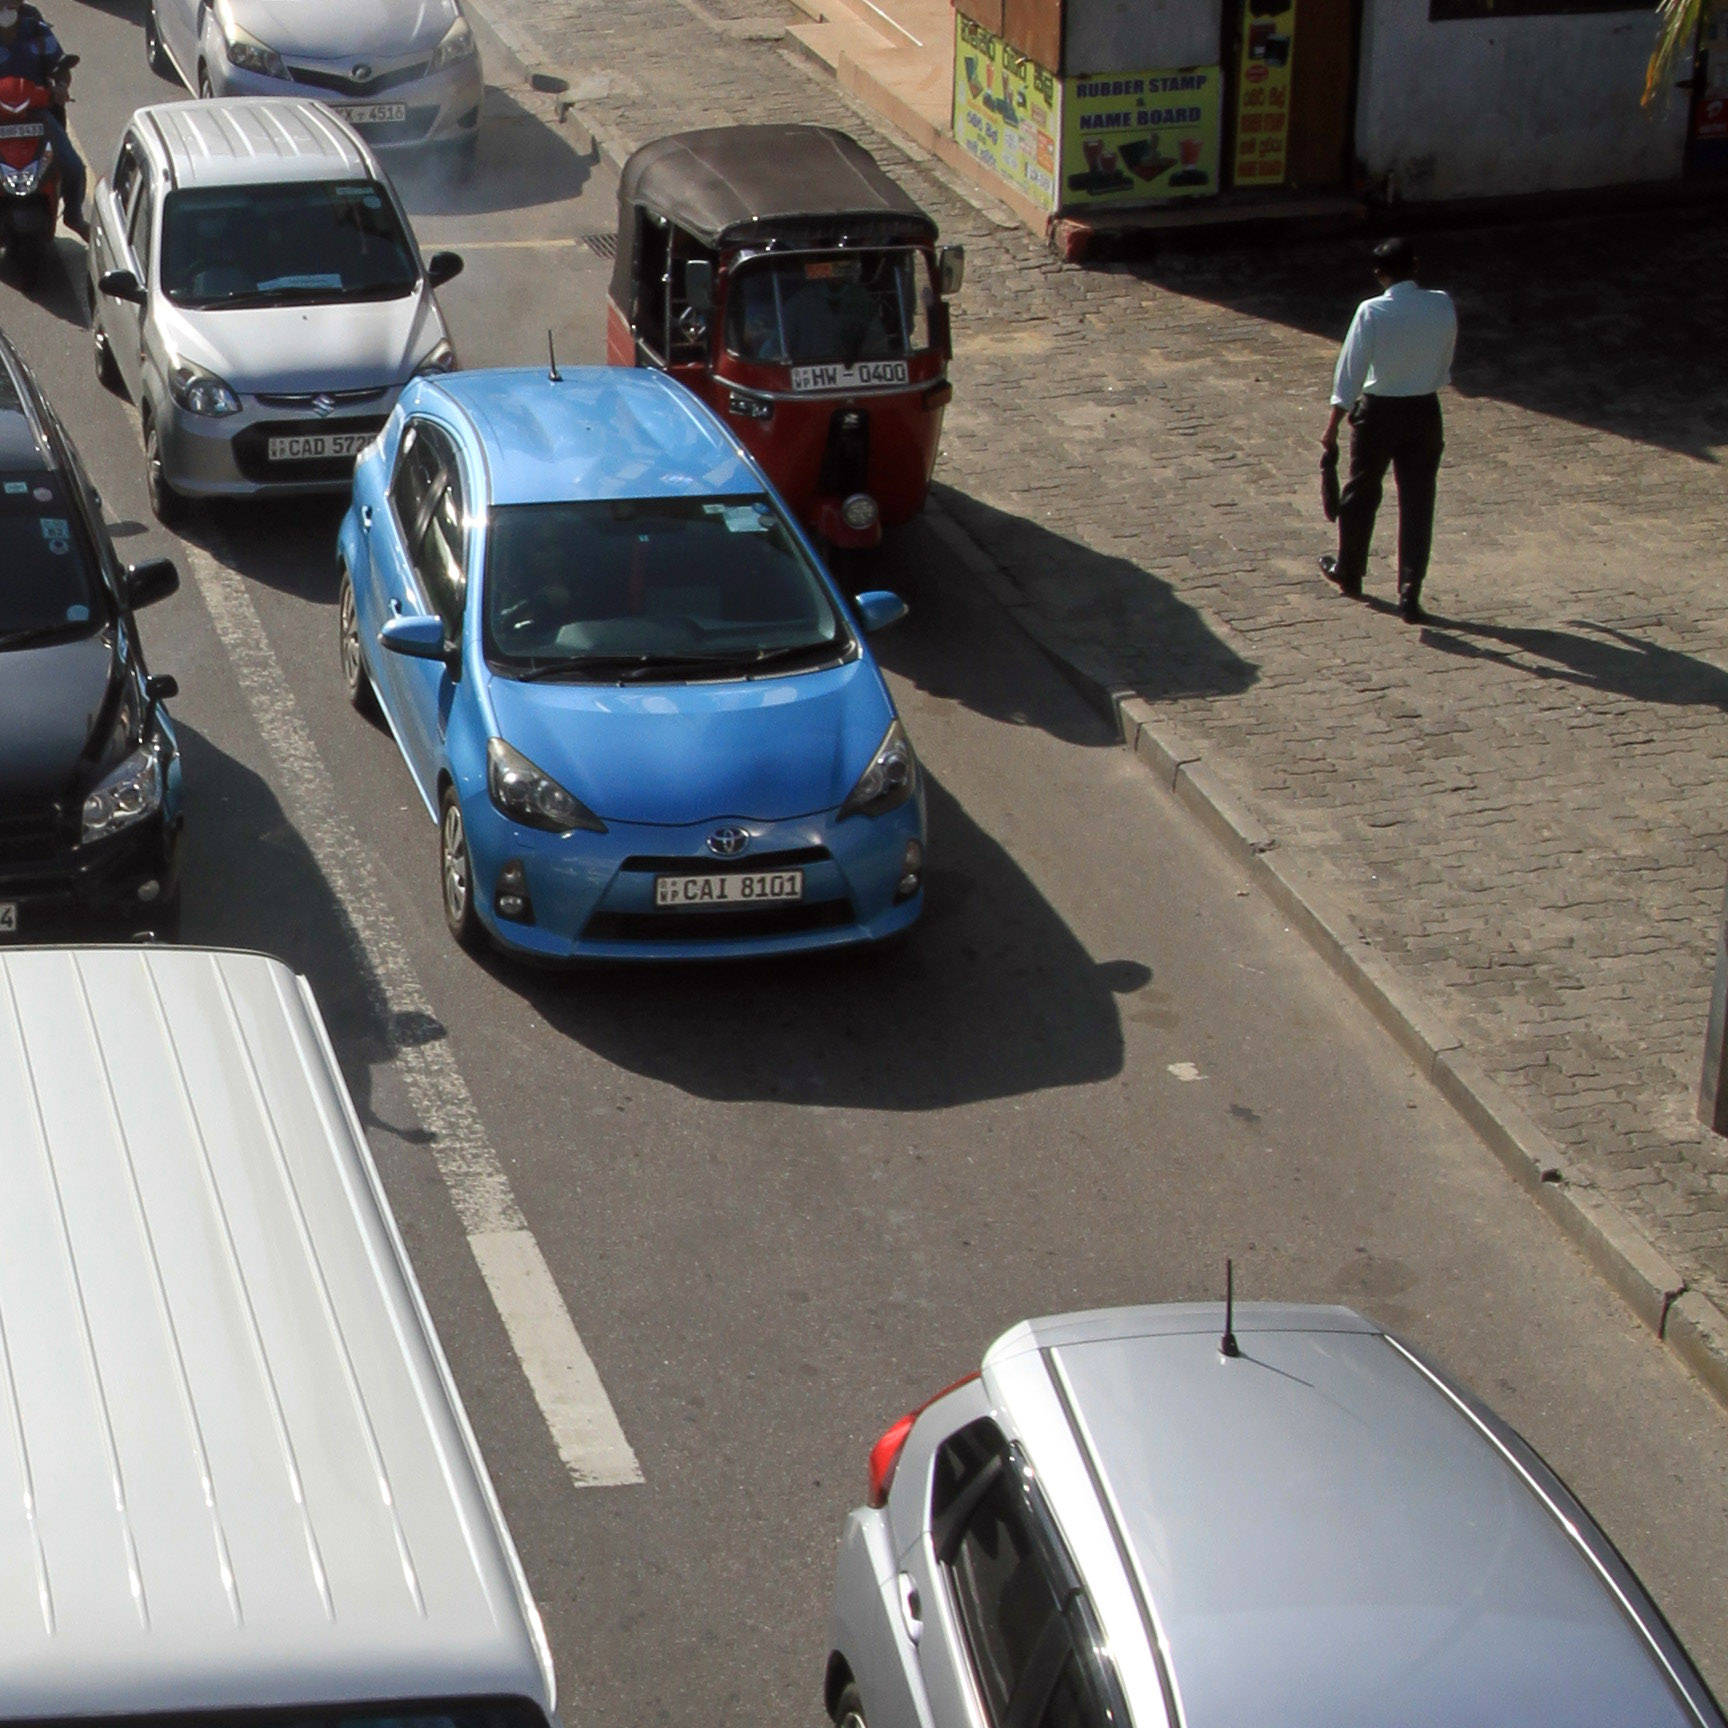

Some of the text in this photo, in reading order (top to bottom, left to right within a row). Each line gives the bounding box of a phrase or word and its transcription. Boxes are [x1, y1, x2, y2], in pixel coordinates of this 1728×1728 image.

[1077, 75, 1207, 99] RUBBER STAMP
[1079, 107, 1202, 130] NAME BOARD
[812, 368, 837, 387] HW
[859, 364, 907, 383] 0400
[289, 438, 326, 456] CAD
[333, 436, 374, 454] 572
[683, 878, 728, 901] CAI
[740, 875, 800, 898] 8101
